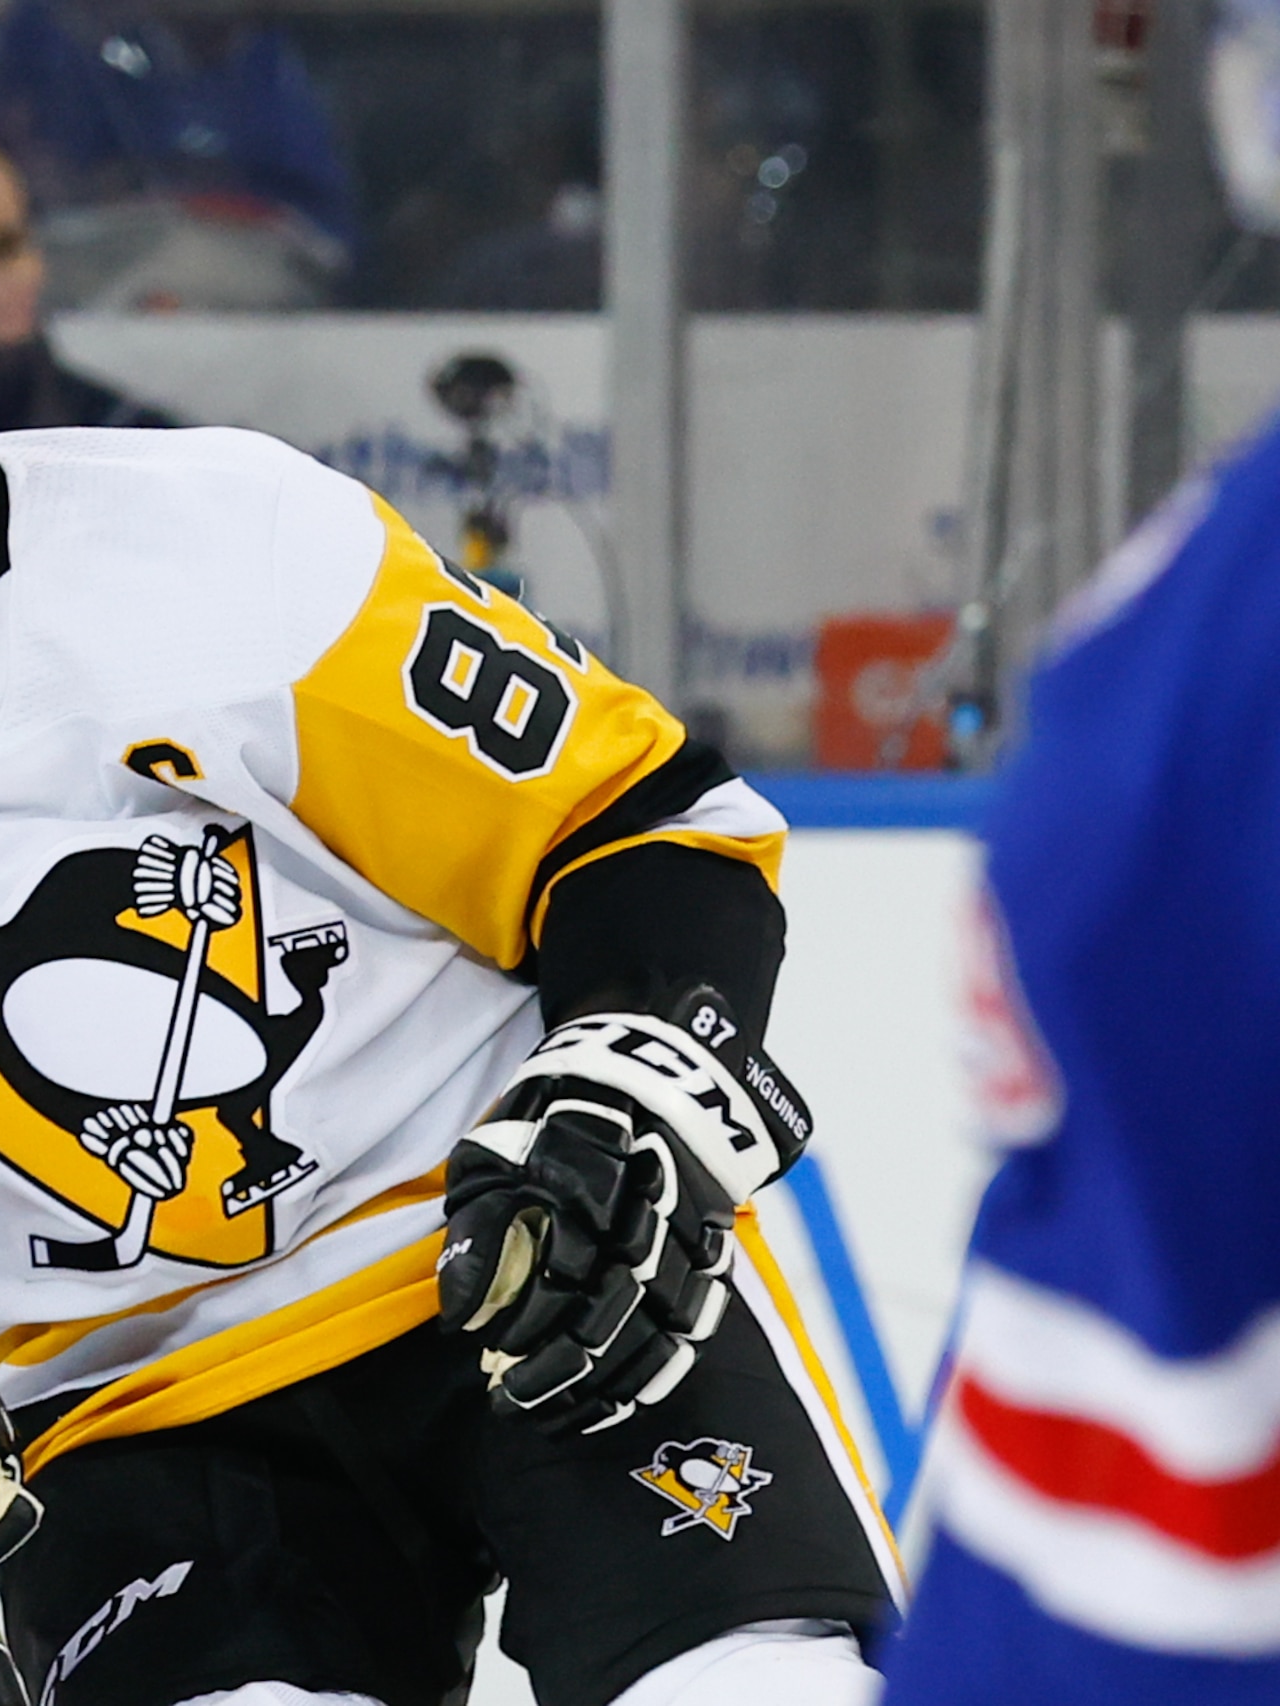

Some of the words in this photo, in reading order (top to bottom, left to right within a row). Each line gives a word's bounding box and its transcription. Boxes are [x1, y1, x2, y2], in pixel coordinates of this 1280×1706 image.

[400, 532, 588, 784] 8
[121, 737, 205, 786] C
[691, 1006, 737, 1049] 87
[522, 1021, 758, 1153] CCM
[436, 1238, 473, 1272] CM
